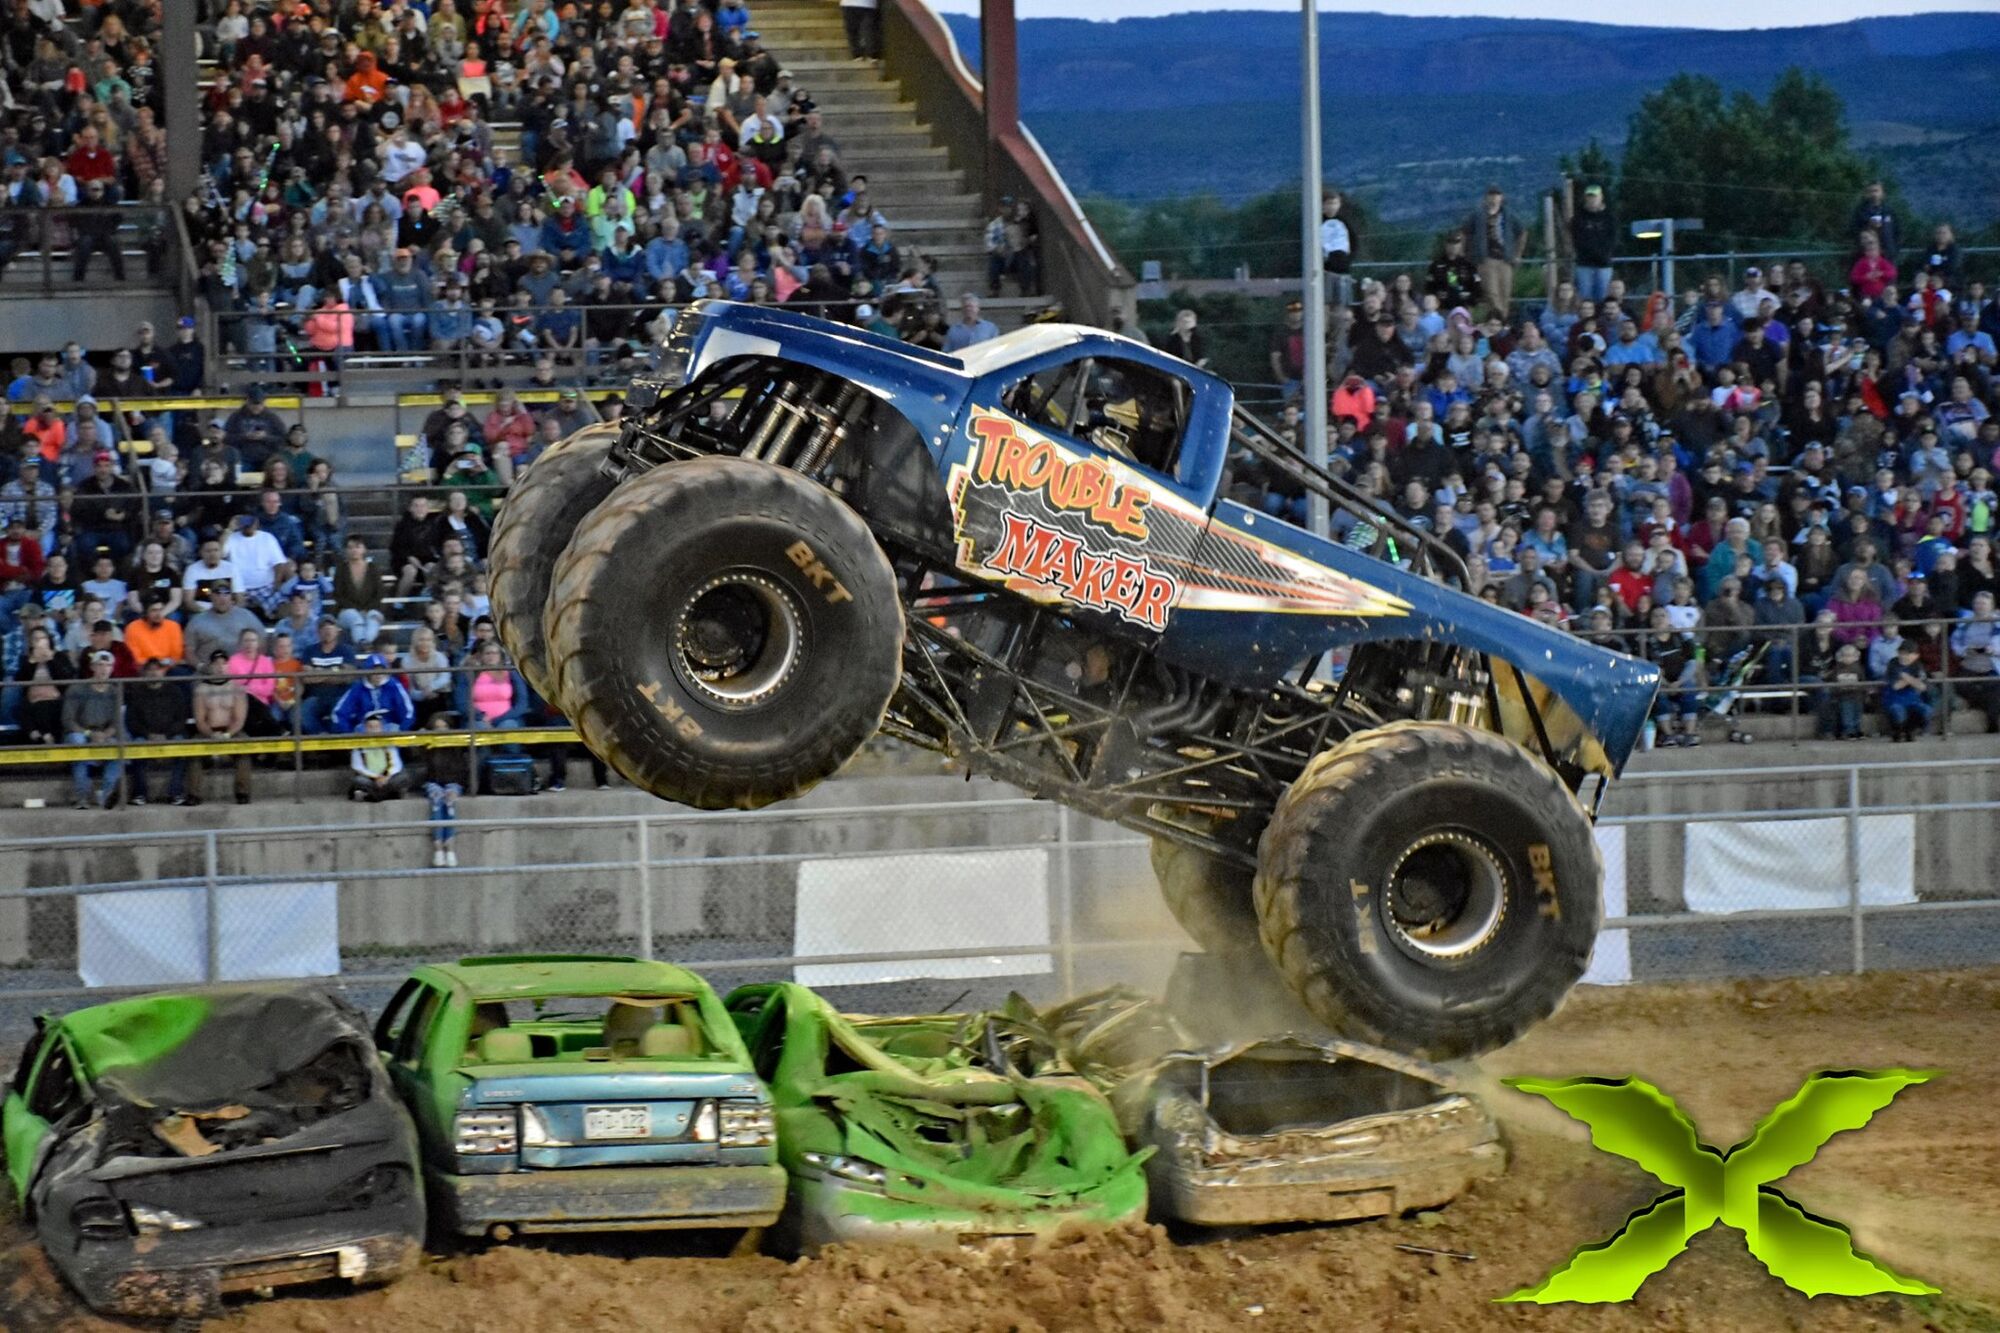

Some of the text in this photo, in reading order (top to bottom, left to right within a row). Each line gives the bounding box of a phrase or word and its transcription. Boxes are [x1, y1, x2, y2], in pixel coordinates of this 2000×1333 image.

[968, 414, 1150, 542] TROUBLE
[785, 540, 853, 604] BKT
[983, 512, 1175, 631] MAKER
[636, 680, 703, 740] BKT
[1528, 843, 1562, 922] BKT
